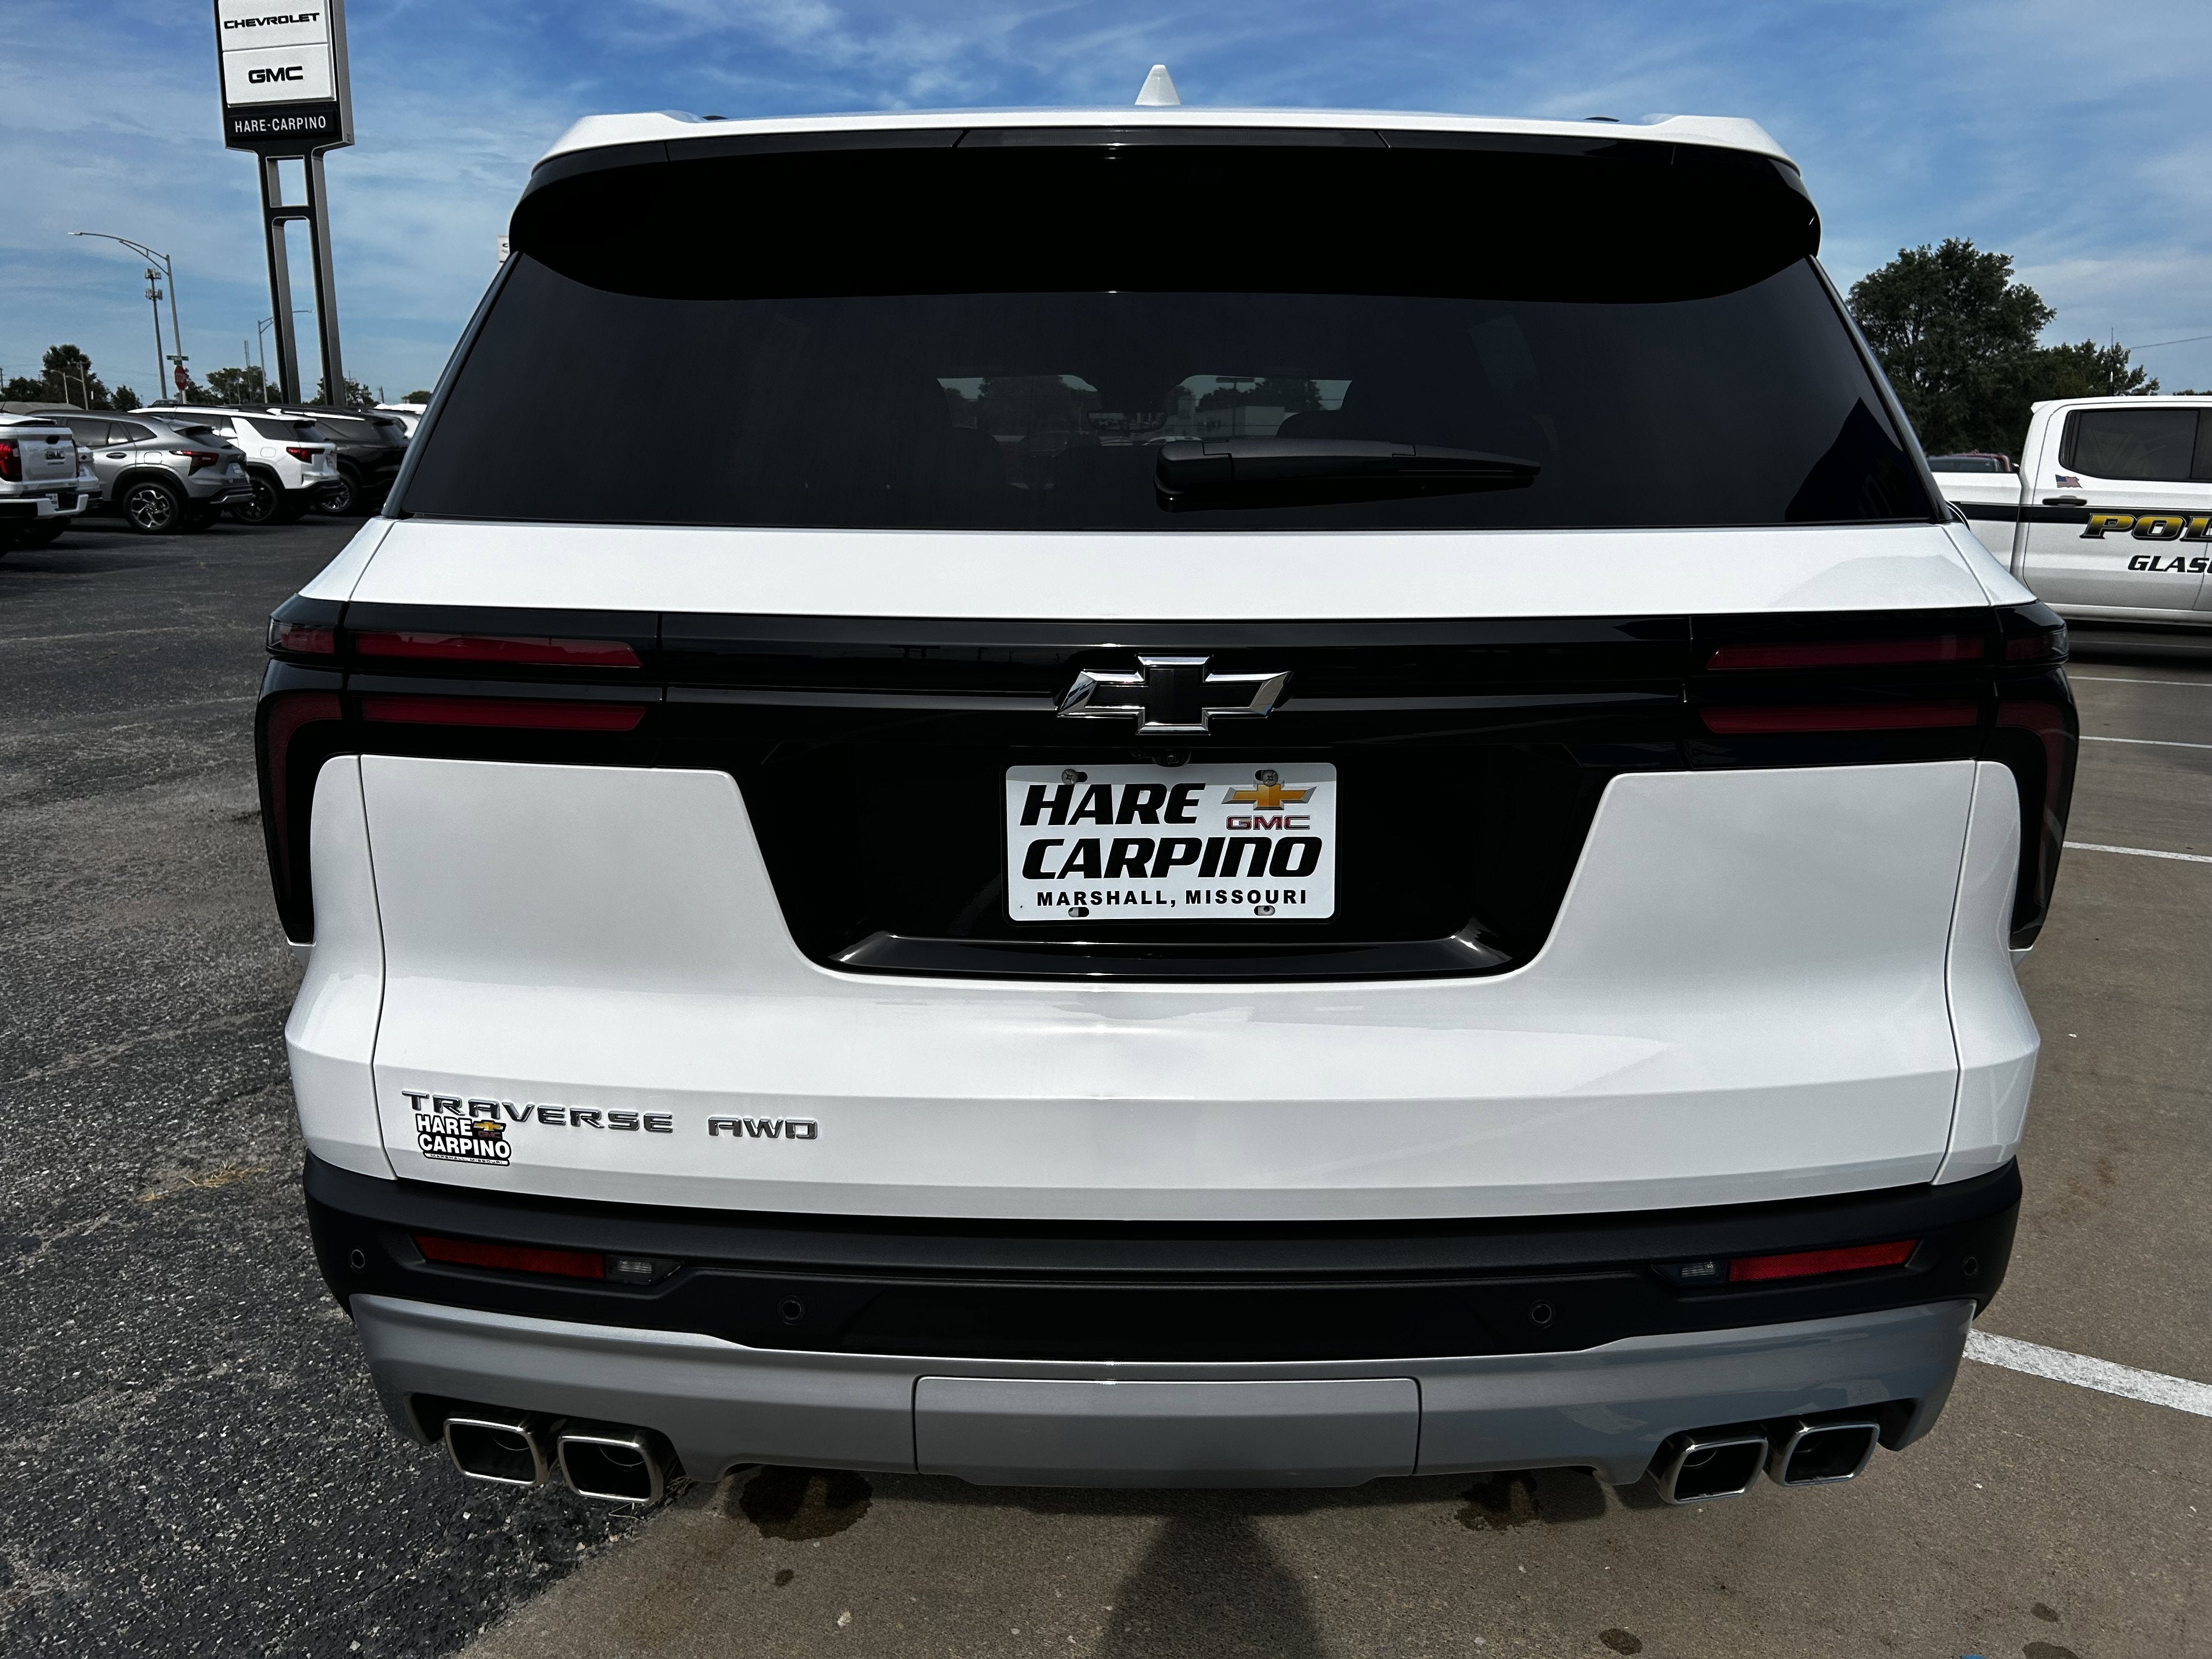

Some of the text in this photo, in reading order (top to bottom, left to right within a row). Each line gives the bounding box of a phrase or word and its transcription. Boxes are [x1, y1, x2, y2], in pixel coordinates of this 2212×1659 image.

[224, 13, 320, 29] CHEVROLET
[248, 66, 303, 83] GMC
[234, 116, 326, 133] HARE-CARPINO
[2128, 555, 2212, 574] GLAS
[1019, 782, 1206, 826] HARE
[1226, 815, 1311, 830] GMC
[1022, 836, 1323, 879] CARPINO
[1037, 889, 1307, 908] MARSHALL, MISSOURI
[401, 1090, 818, 1139] TRAVERSE AWD
[416, 1114, 473, 1136] HARE
[419, 1133, 510, 1158] CARPINO
